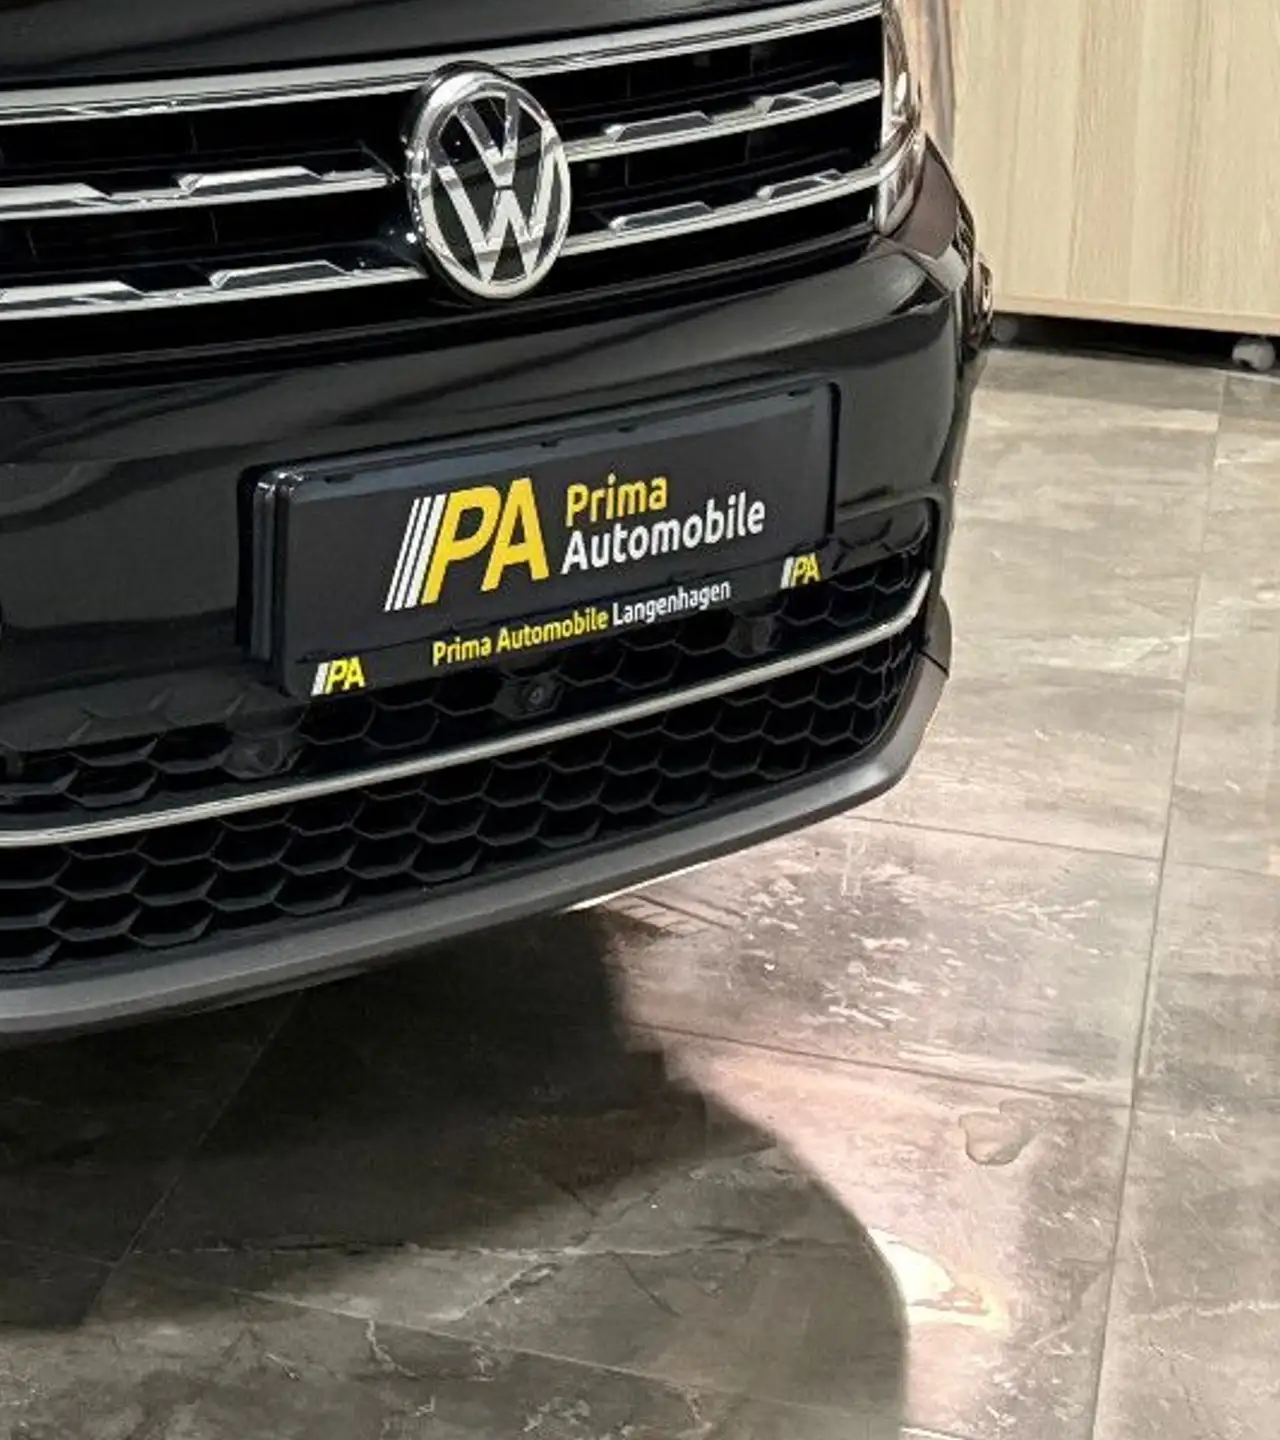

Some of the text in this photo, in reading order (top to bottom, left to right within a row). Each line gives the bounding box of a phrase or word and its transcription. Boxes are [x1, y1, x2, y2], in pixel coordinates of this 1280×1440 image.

[559, 491, 766, 575] Automobile
[565, 472, 668, 528] Prima
[432, 581, 731, 667] Prima Automobile Langenhagen
